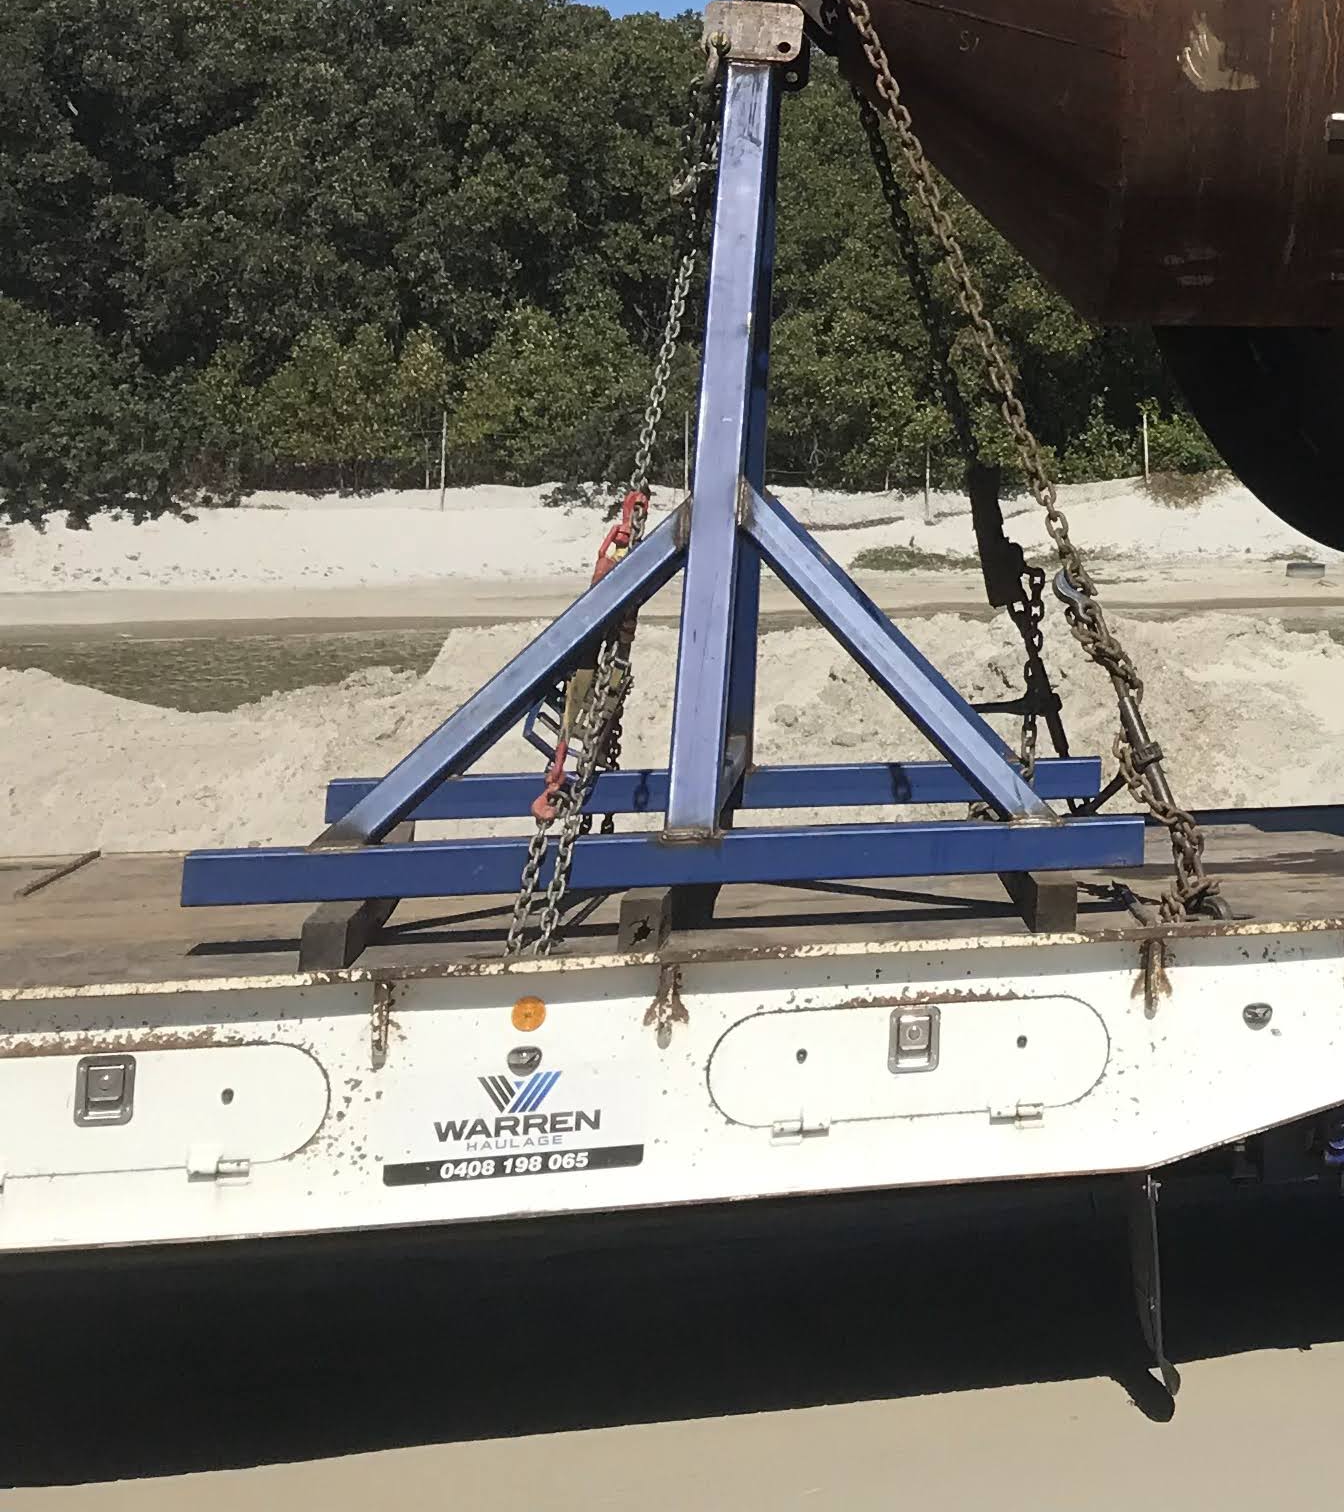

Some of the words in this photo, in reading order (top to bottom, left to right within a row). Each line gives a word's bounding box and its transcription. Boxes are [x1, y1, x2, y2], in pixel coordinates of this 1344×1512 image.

[434, 1109, 601, 1142] WARREN
[466, 1134, 563, 1152] HAULAGE
[440, 1159, 496, 1179] 0408
[503, 1155, 542, 1174] 198
[548, 1151, 589, 1170] 065
